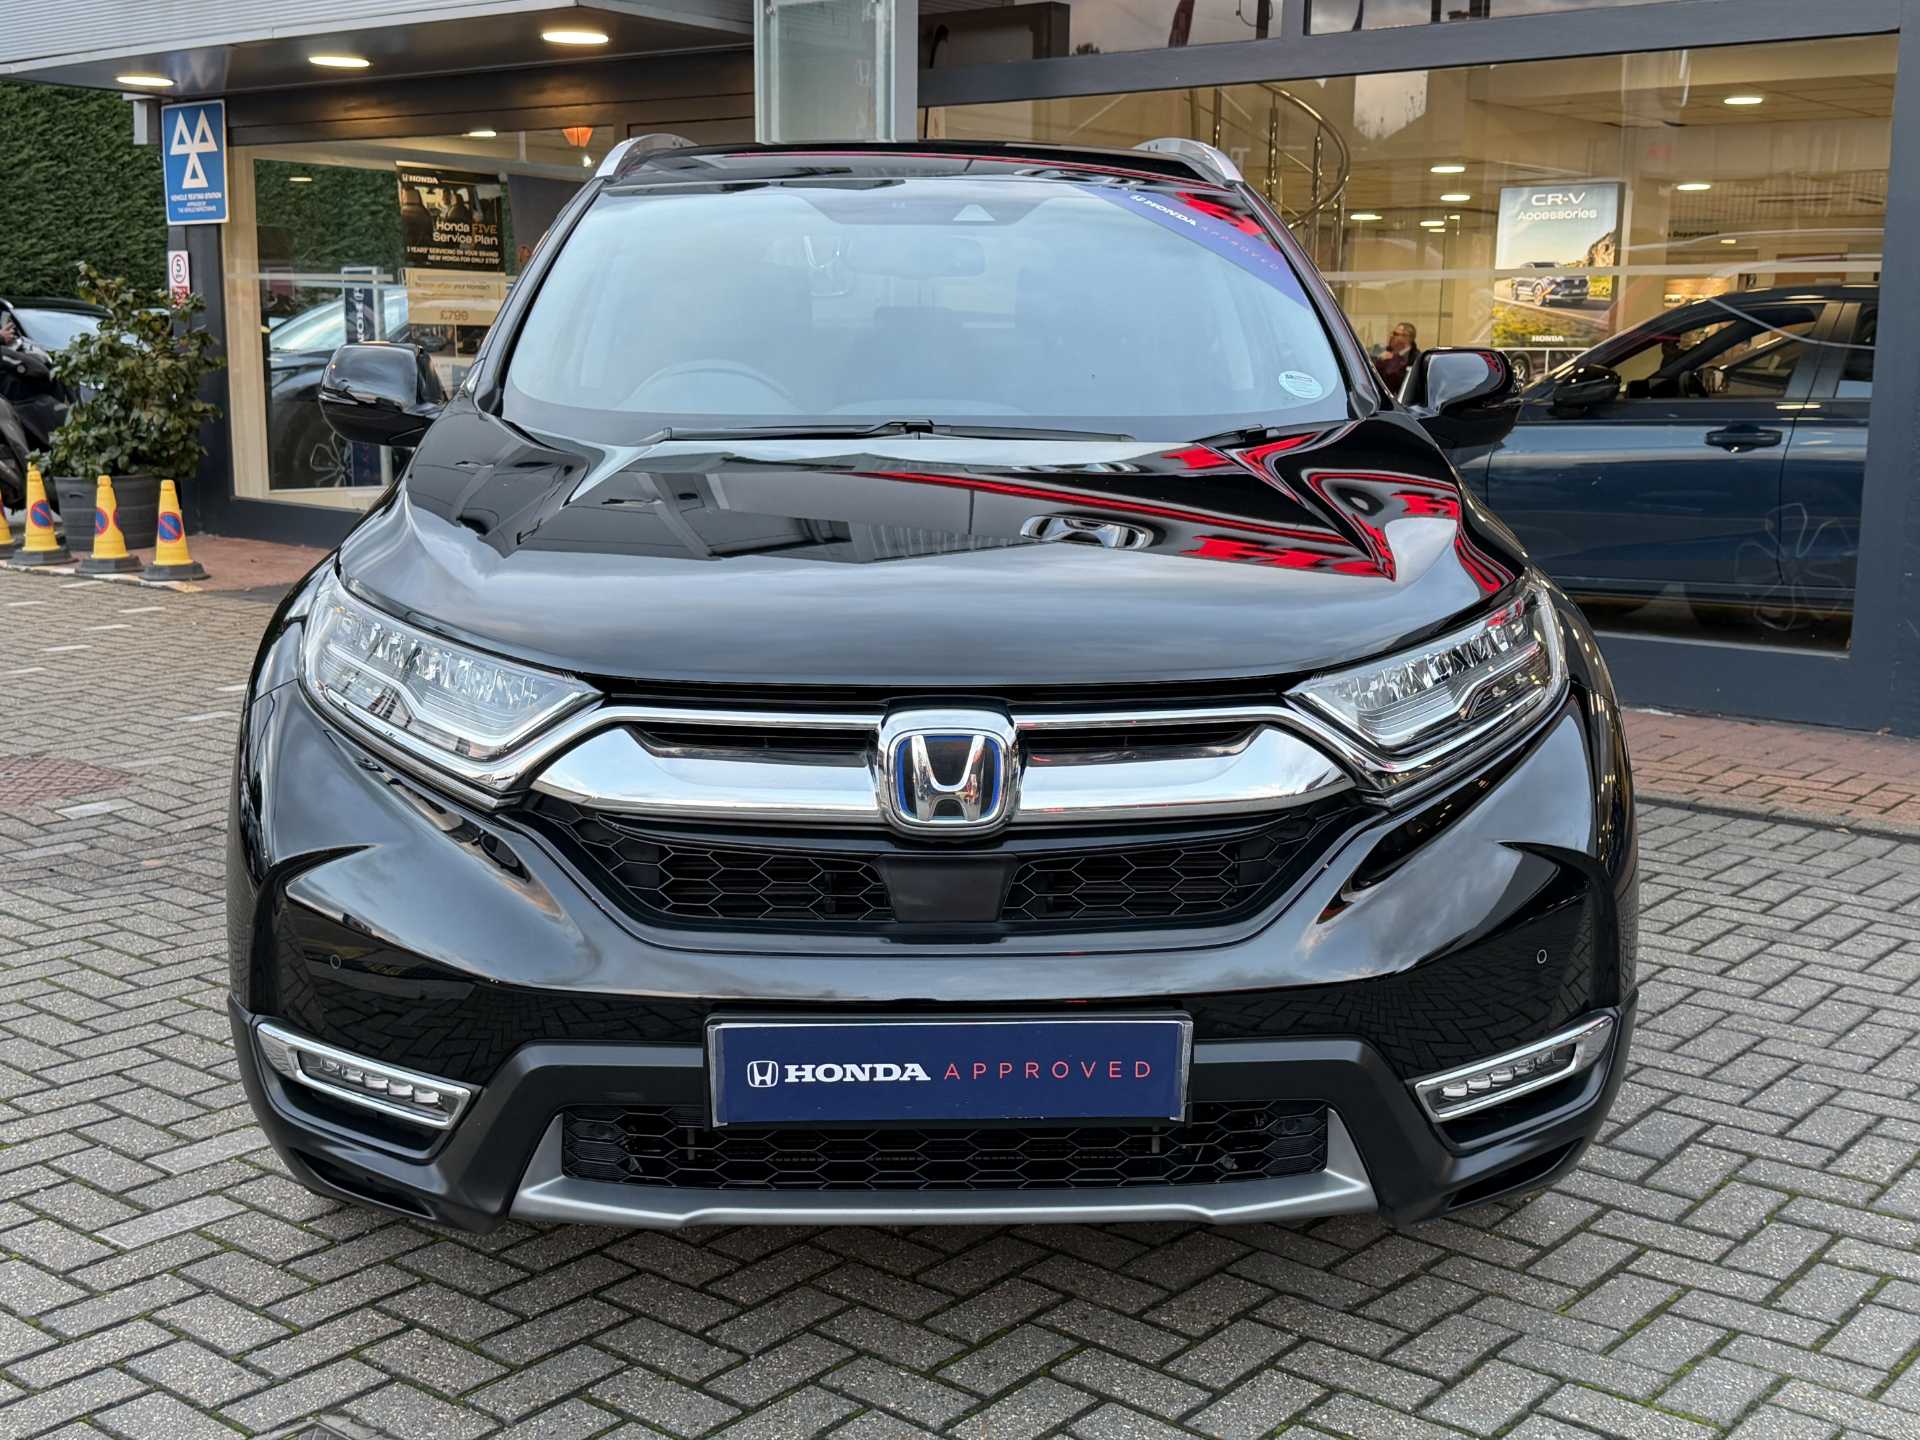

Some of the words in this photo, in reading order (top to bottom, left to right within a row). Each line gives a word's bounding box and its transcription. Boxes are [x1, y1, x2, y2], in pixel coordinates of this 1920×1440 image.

[409, 174, 439, 184] HONDA
[1531, 192, 1586, 206] CR-V
[1144, 200, 1197, 226] HONDA
[1518, 208, 1598, 221] Accessories
[436, 220, 470, 232] Honda
[472, 224, 498, 234] FIVE
[433, 231, 473, 244] Service
[474, 235, 498, 246] Plan
[784, 1062, 931, 1083] HONDA
[944, 1060, 1151, 1081] APPROVED
